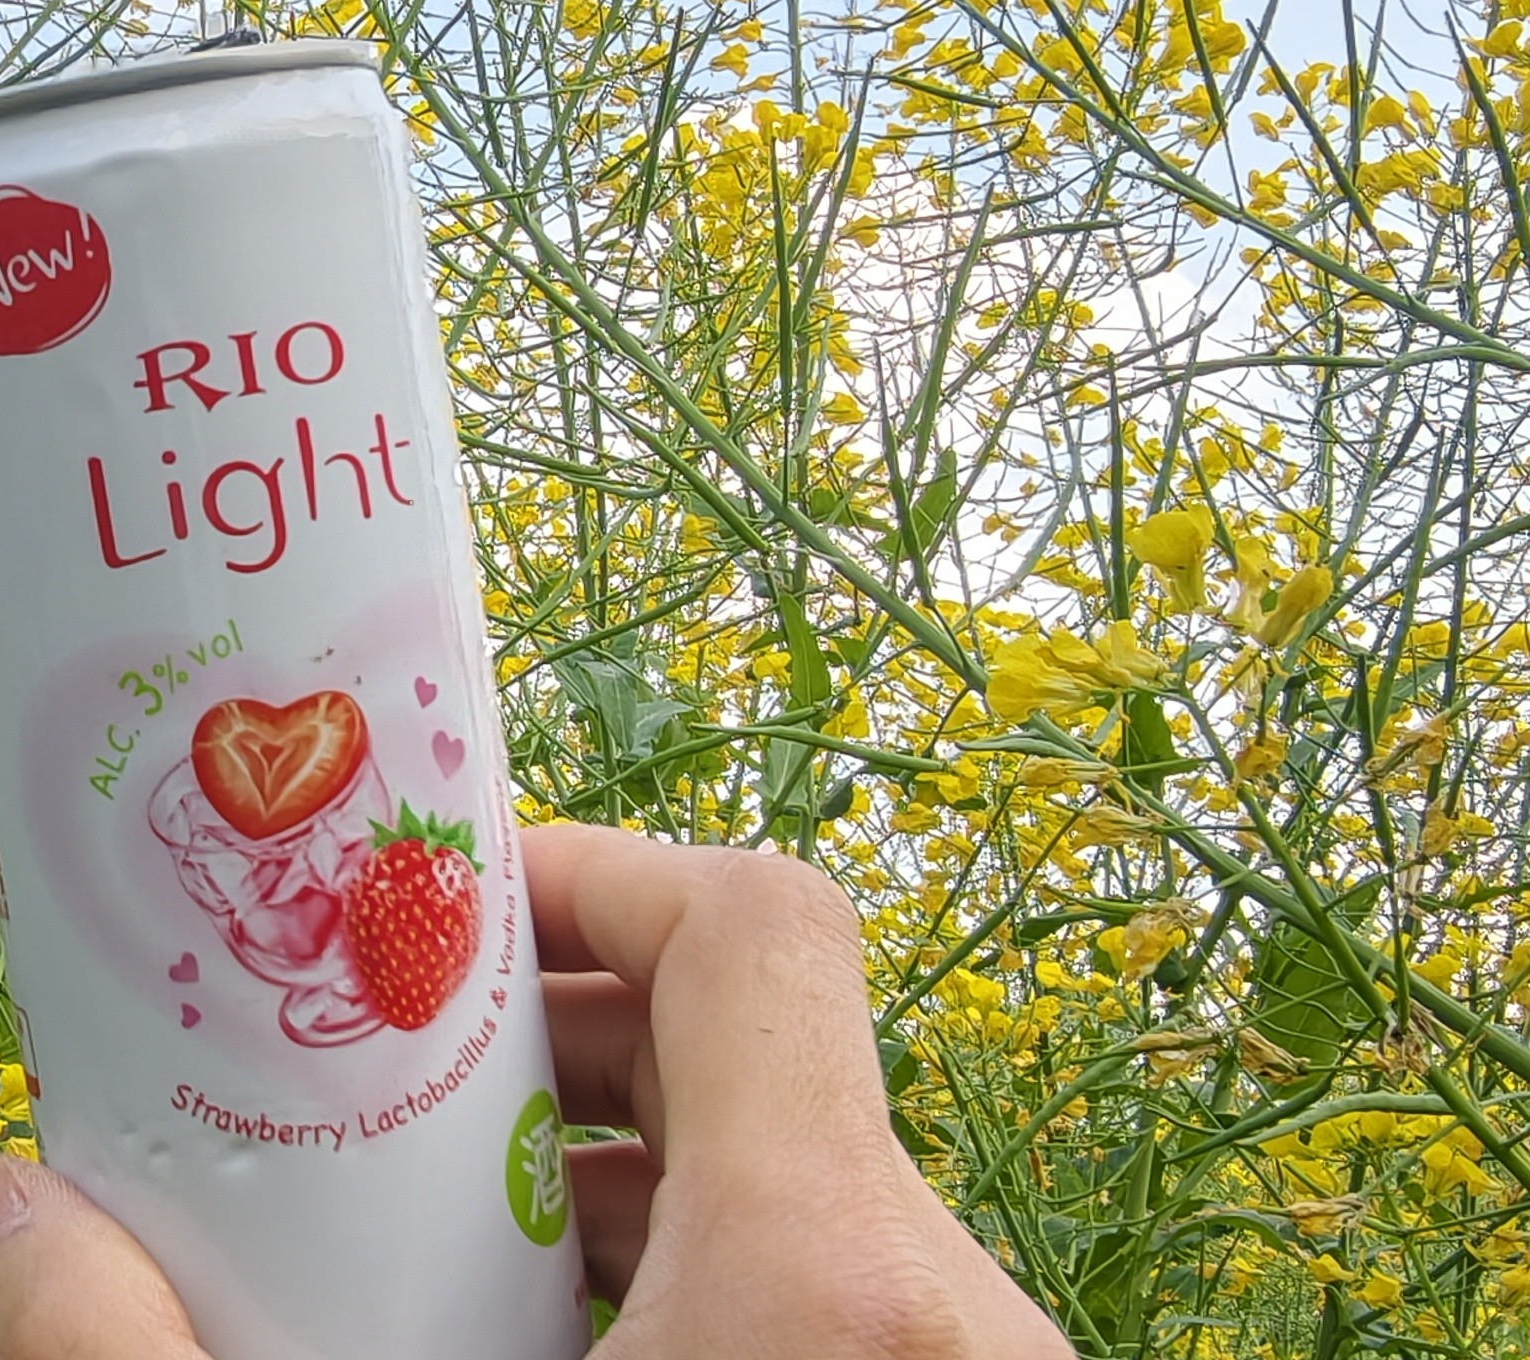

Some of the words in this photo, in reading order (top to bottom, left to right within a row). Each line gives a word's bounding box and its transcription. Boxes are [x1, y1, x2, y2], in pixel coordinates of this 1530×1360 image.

[133, 321, 346, 415] RIO
[86, 412, 415, 575] Light
[88, 723, 141, 801] ALC.
[185, 618, 244, 668] vol
[170, 1083, 348, 1153] Strawberry
[357, 1015, 499, 1140] Lactobacillus
[488, 985, 509, 1012] &
